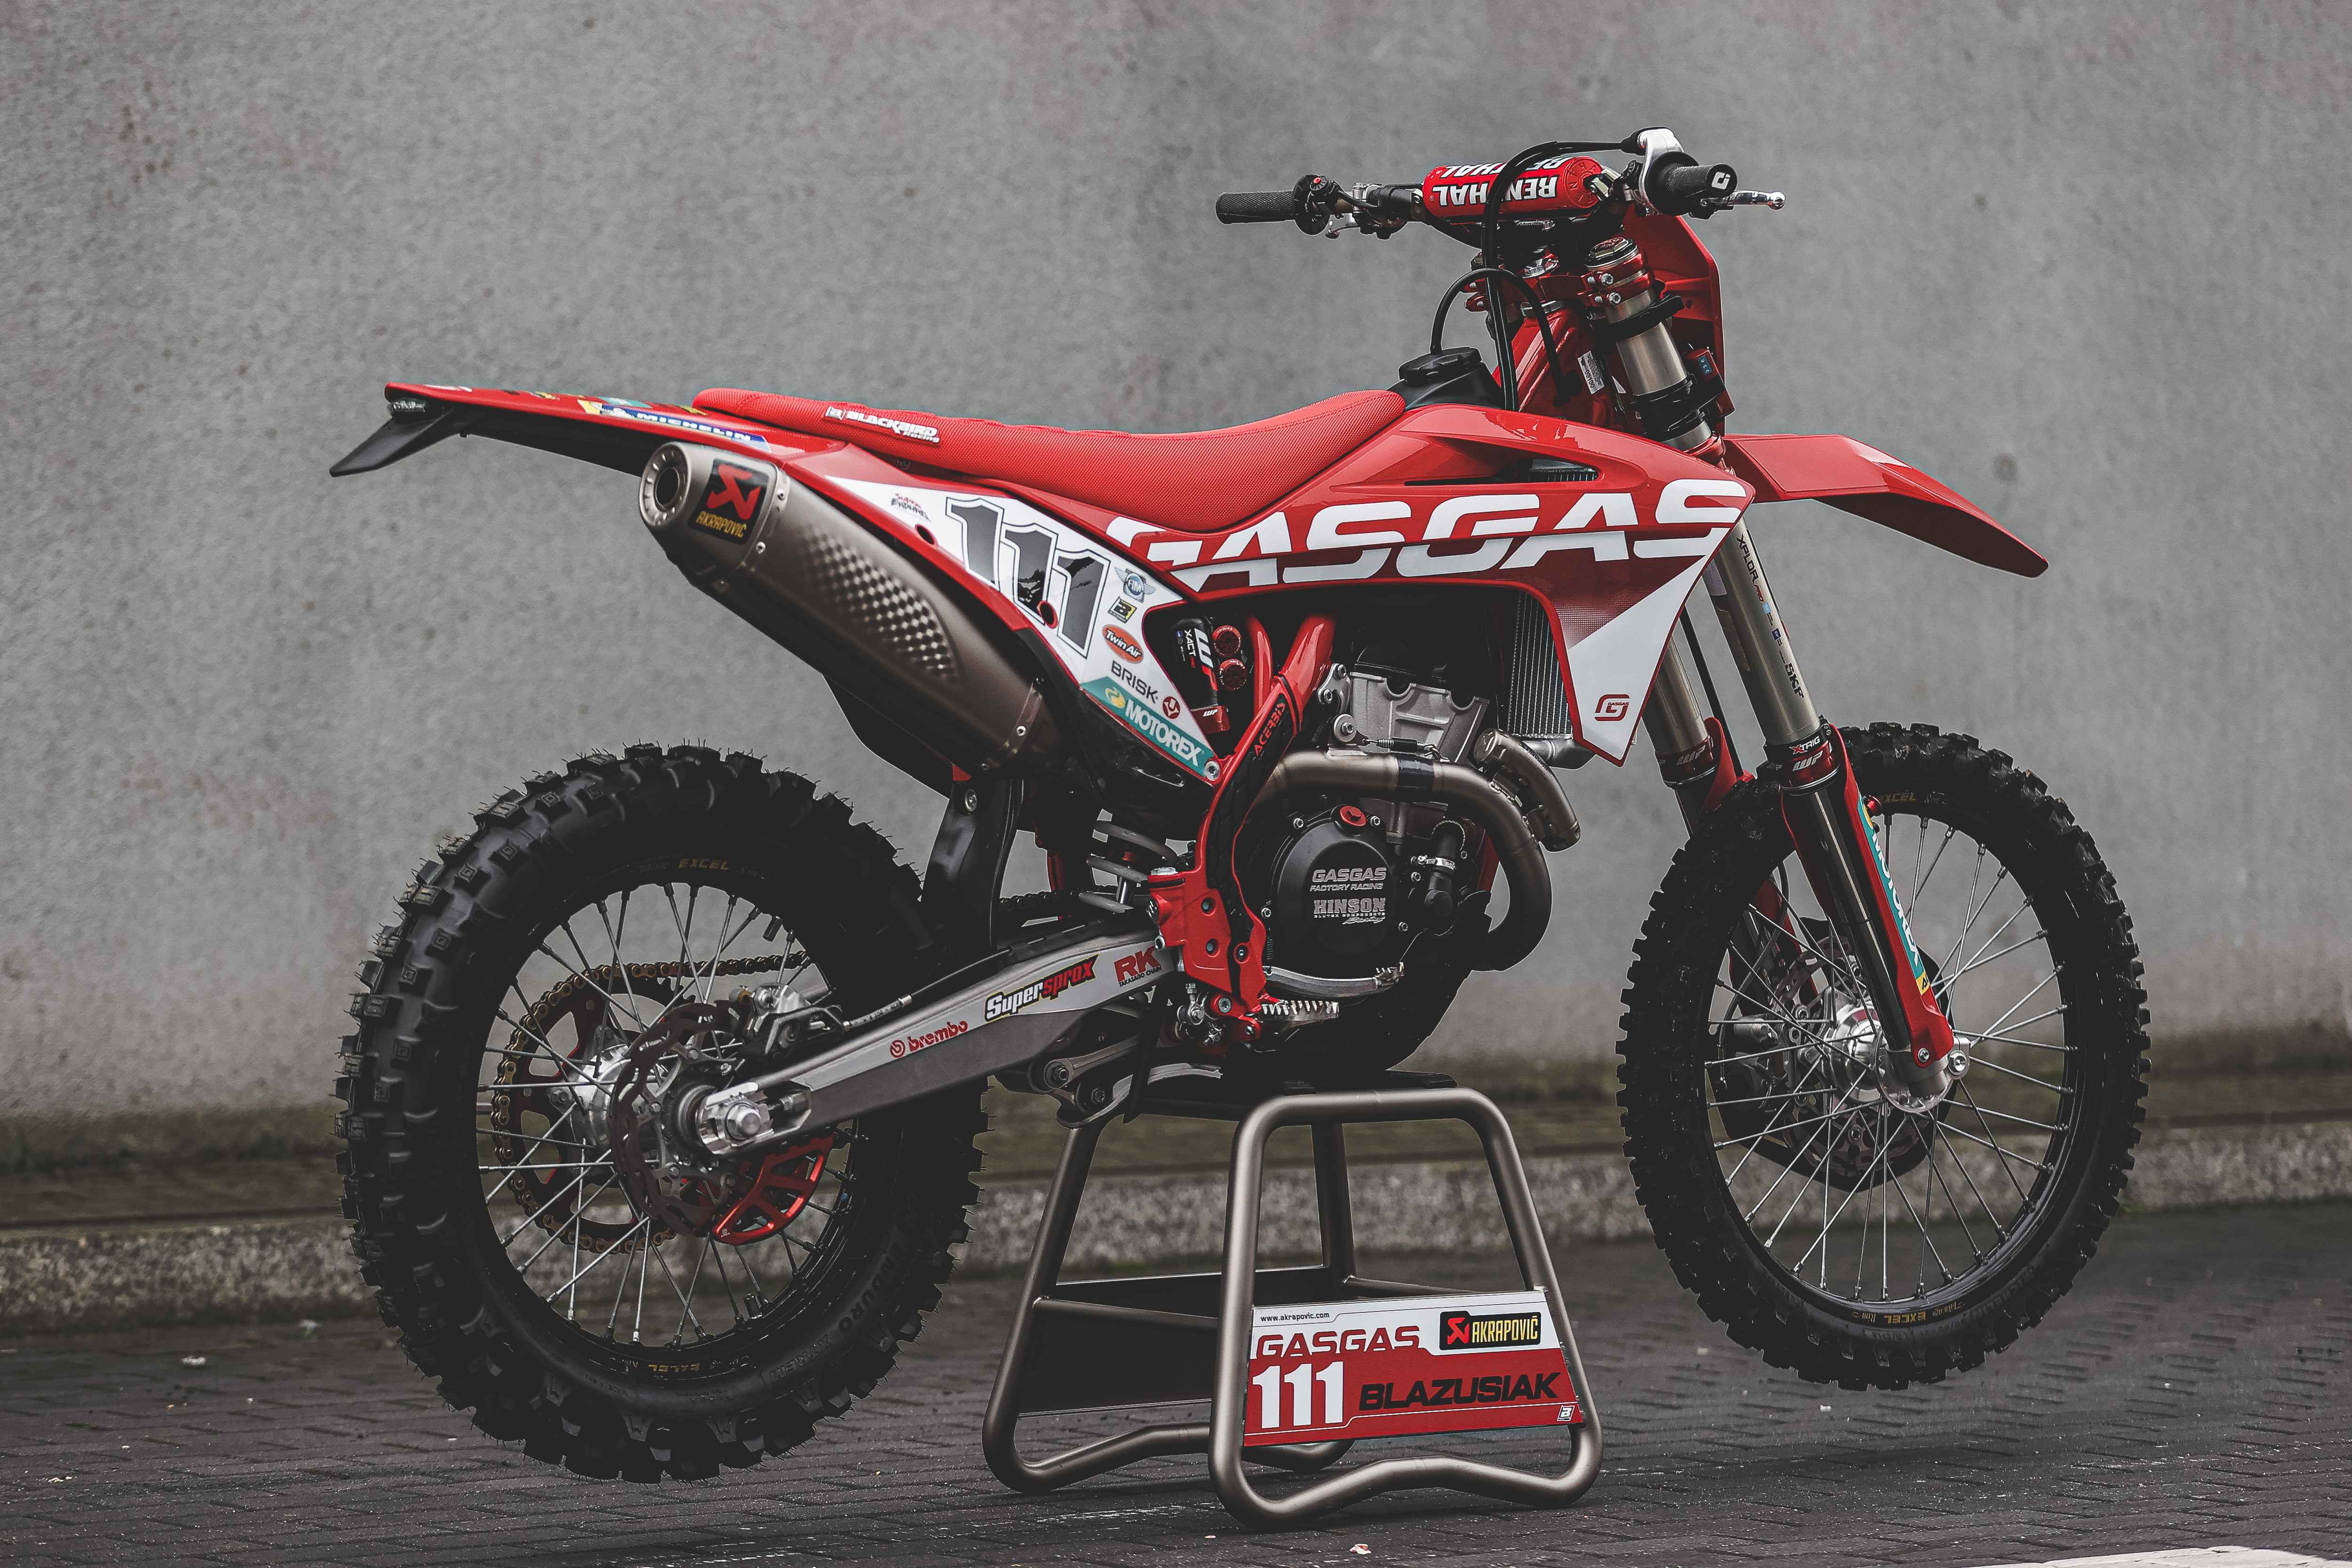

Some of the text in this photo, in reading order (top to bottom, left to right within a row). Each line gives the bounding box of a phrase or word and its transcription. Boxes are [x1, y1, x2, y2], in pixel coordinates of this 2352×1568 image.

[1432, 175, 1558, 207] RENHAL
[636, 413, 751, 441] MICHELIN
[846, 410, 938, 437] BLACKBIRD
[1106, 479, 1747, 592] GASGAS
[1736, 533, 1760, 584] XPLOR
[946, 497, 1111, 659] 111
[1128, 579, 1143, 593] FIM
[1106, 629, 1142, 658] Twin Air
[1184, 629, 1196, 656] XACT
[1111, 660, 1158, 704] BRISK
[1784, 662, 1805, 700] SKF
[1202, 708, 1218, 717] WP
[1125, 699, 1202, 767] MOTOREX
[1789, 735, 1820, 755] XTRIG
[1677, 743, 1706, 765] WP
[1793, 749, 1824, 772] WP
[678, 858, 730, 870] EXCEL
[1312, 867, 1387, 883] GASGAS
[1313, 897, 1386, 914] HINSON
[1113, 945, 1161, 983] RK
[1118, 965, 1162, 987] TAKASAGO CHAIN
[986, 960, 1094, 1020] Supersprox
[908, 1019, 969, 1052] brembo
[1260, 1312, 1330, 1323] www.akrapovic.com
[1883, 1311, 1926, 1325] EXCEL
[1256, 1325, 1420, 1359] GASGAS
[1252, 1361, 1344, 1429] 111
[1359, 1372, 1562, 1411] BLAZUSIAK
